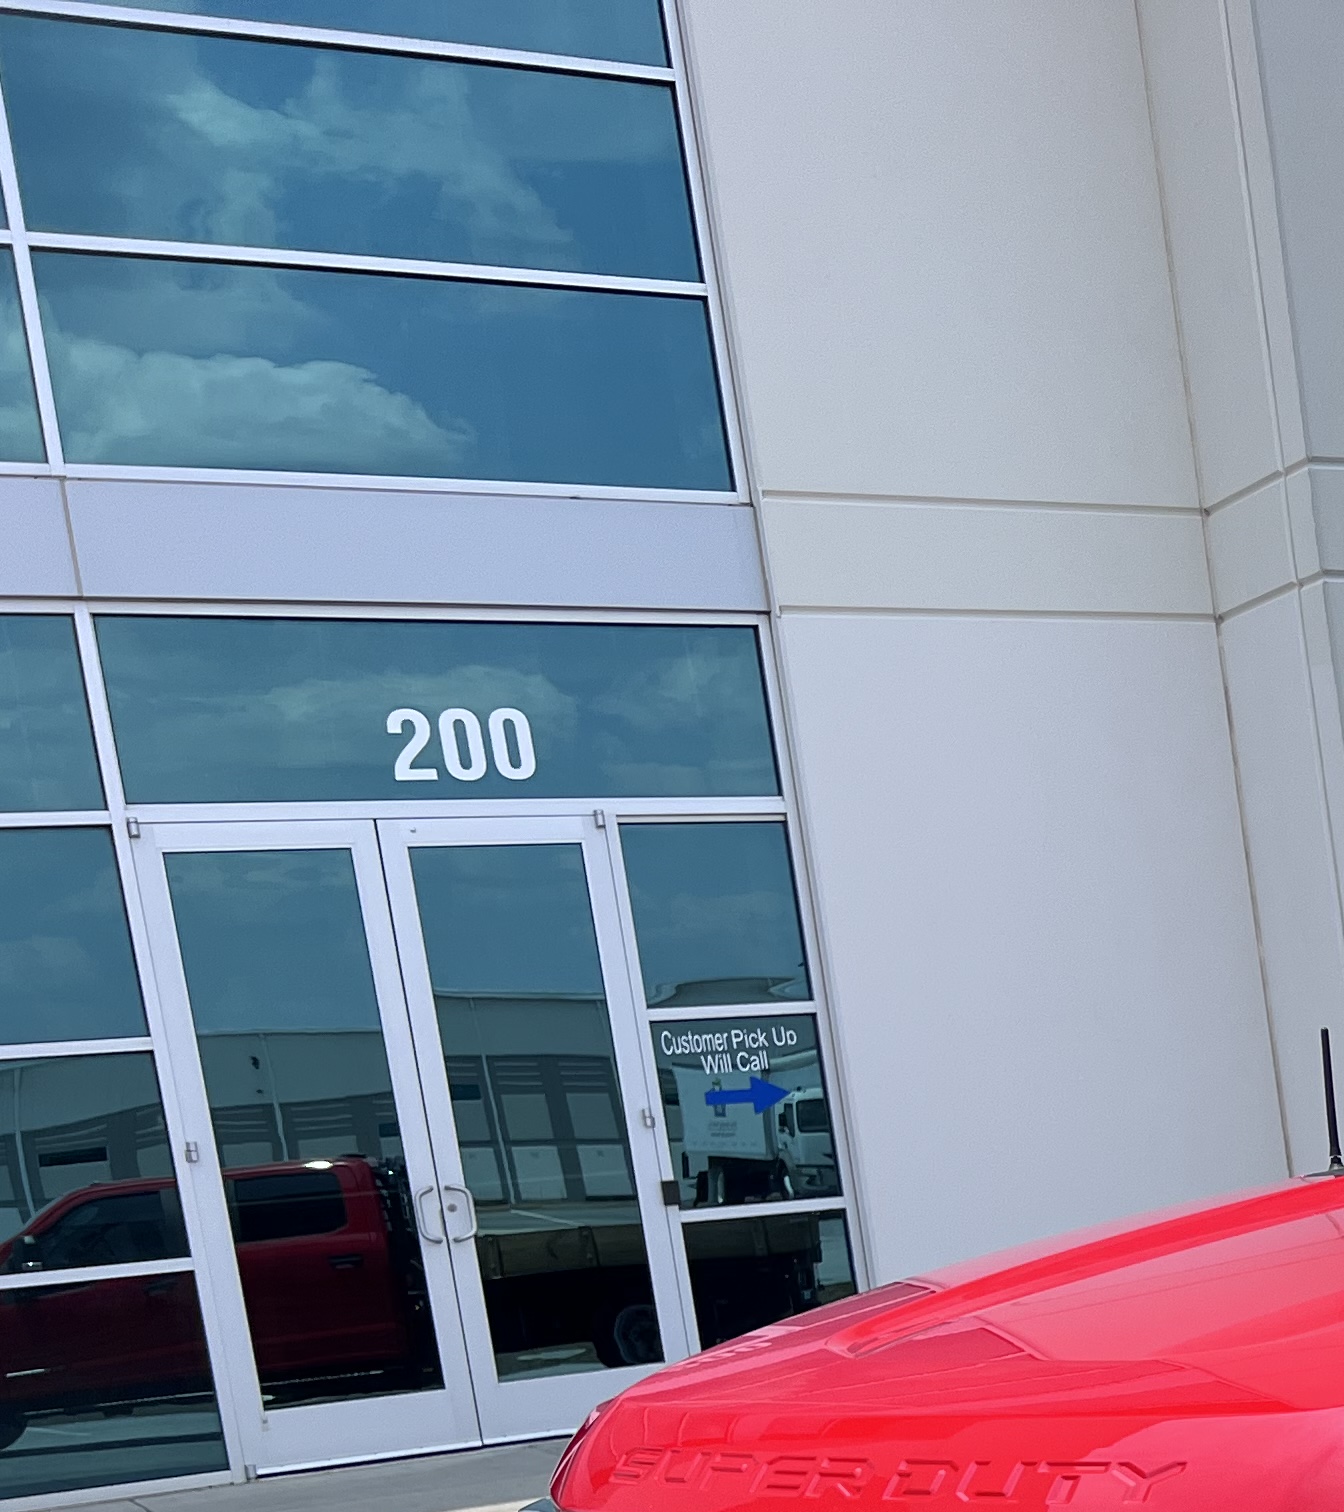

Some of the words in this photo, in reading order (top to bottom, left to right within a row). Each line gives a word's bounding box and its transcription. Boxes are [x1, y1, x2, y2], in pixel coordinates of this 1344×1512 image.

[385, 706, 537, 781] 200
[660, 1029, 728, 1056] Customer
[730, 1027, 769, 1050] Pick
[700, 1052, 733, 1076] Will
[736, 1050, 769, 1073] Call
[608, 1446, 874, 1499] SUPER
[881, 1458, 1188, 1505] DUTY
